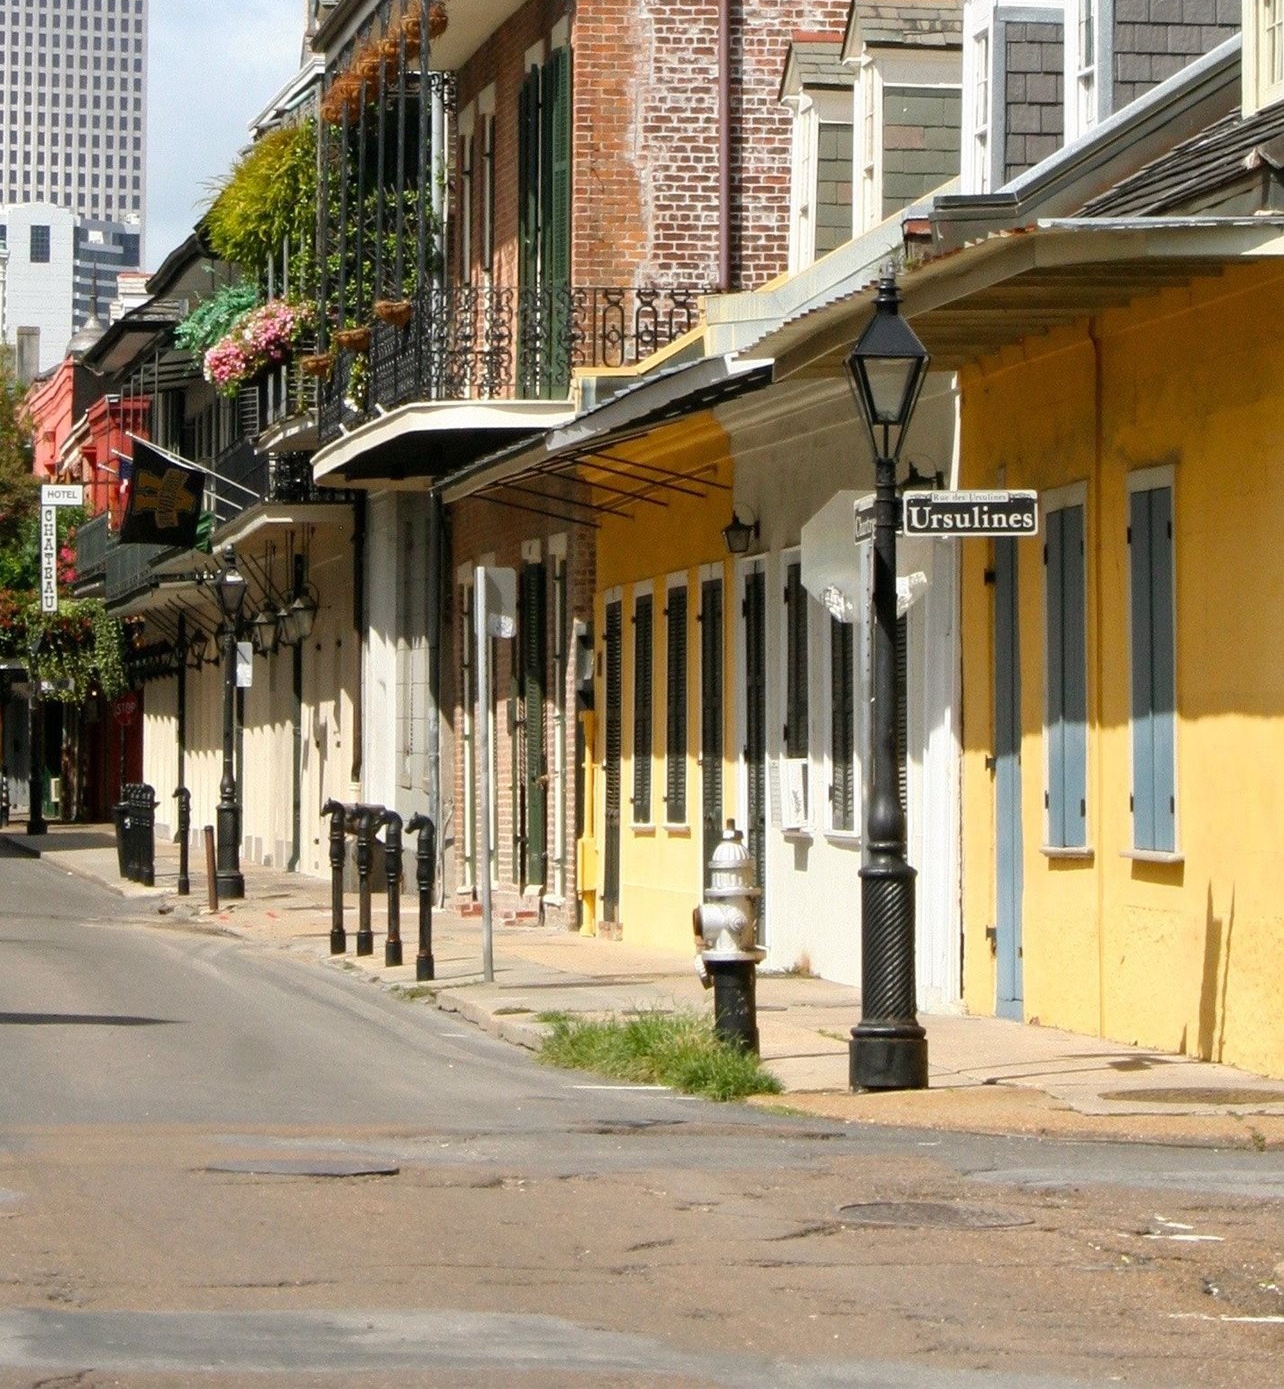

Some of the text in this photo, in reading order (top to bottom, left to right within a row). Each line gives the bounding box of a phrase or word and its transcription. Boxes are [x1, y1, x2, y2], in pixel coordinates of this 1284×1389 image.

[47, 490, 78, 499] HOTEL
[952, 493, 966, 501] des
[969, 493, 1007, 501] Ursulines
[908, 505, 1033, 529] Ursulines
[44, 510, 54, 608] CHATEAU
[115, 701, 137, 715] STOP
